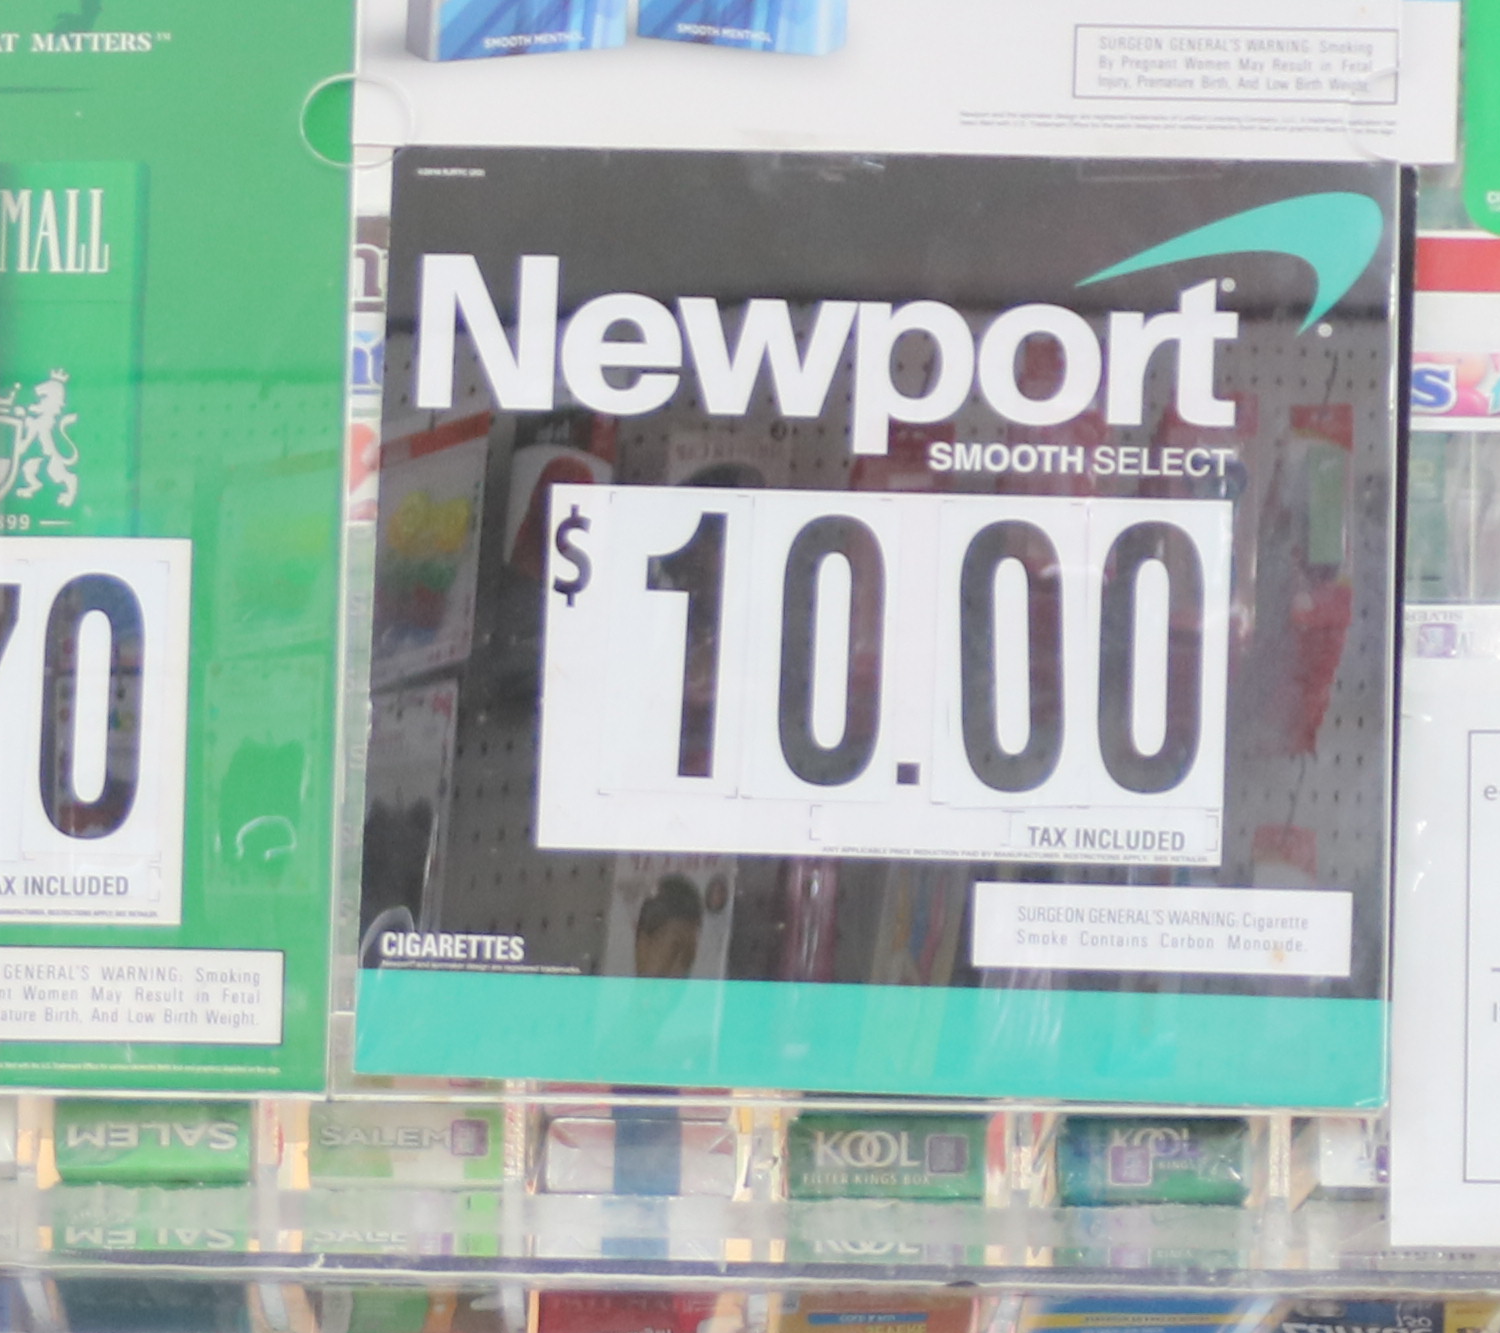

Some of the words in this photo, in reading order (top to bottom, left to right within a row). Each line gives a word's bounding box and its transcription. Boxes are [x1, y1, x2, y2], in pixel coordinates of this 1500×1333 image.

[417, 252, 1239, 456] Newport
[929, 445, 1084, 473] SMOOTH
[1092, 447, 1233, 478] SELECT
[645, 512, 1207, 794] 10.00
[23, 875, 129, 898] INCLUDED
[380, 933, 525, 962] CIGARETTES
